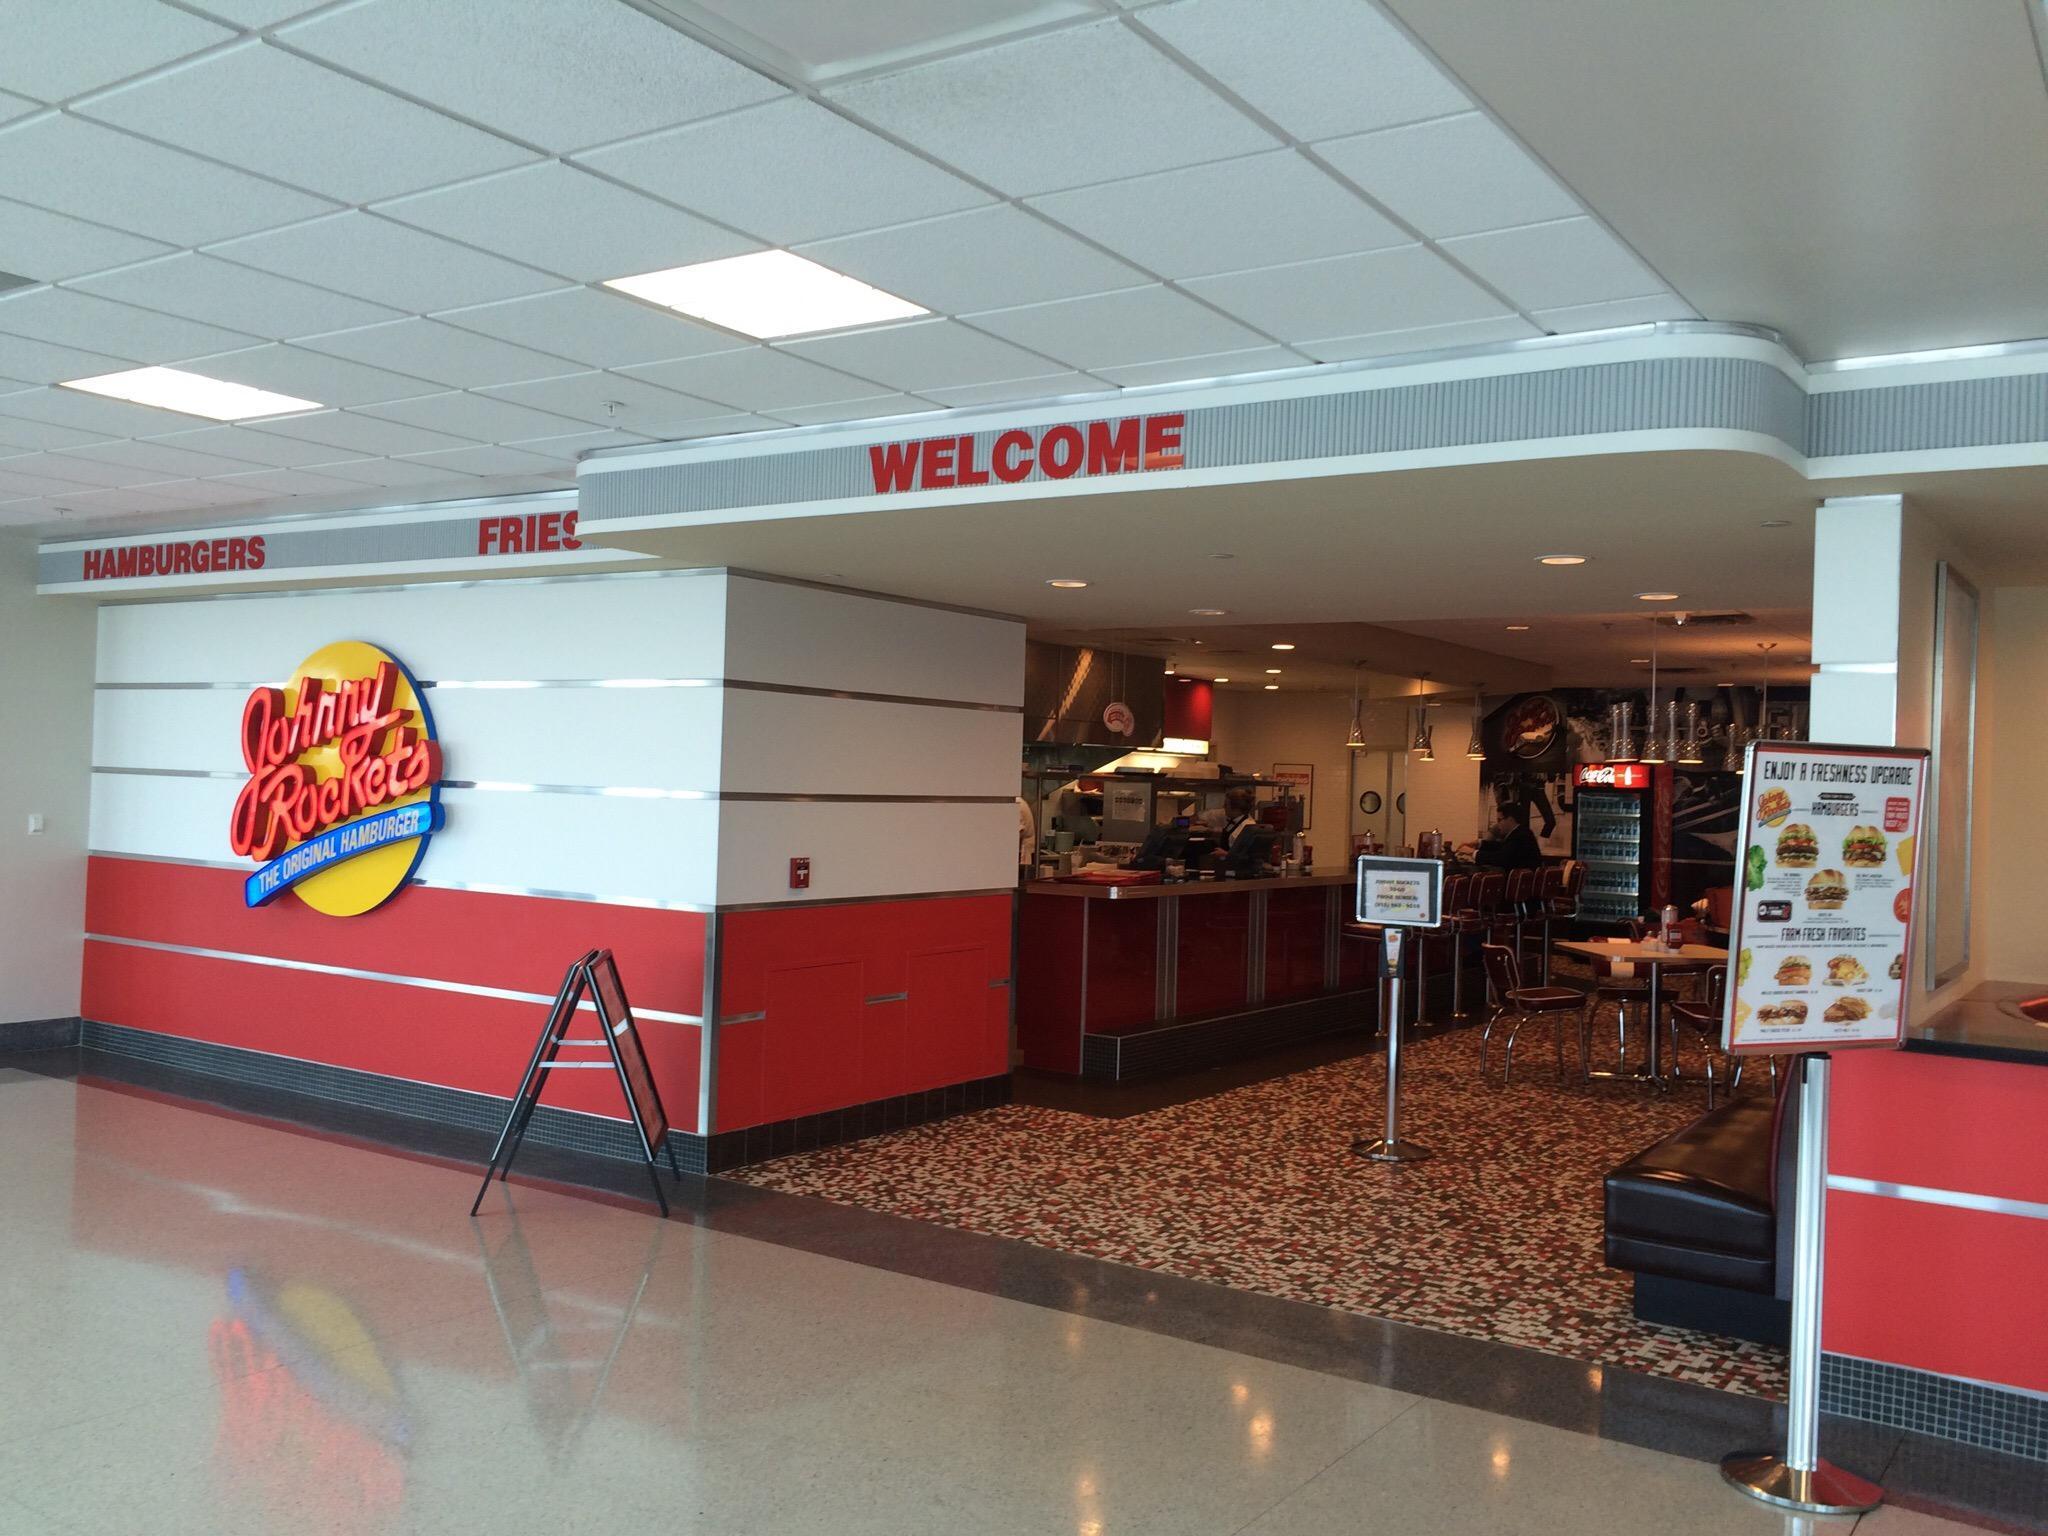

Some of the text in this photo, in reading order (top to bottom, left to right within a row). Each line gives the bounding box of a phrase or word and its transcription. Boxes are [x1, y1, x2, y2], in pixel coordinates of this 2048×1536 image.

[869, 413, 1184, 494] WELCOME
[479, 510, 582, 555] FRIES
[83, 535, 266, 581] HAMBURGERS
[252, 726, 438, 862] Rockets
[1764, 761, 1913, 785] ENJOY A FRESHNESS UPGRADE
[1811, 802, 1859, 816] HAMBURGERS
[258, 809, 420, 894] THE ORIGINAL HAMBURGER
[1828, 927, 1866, 941] FAVORITES
